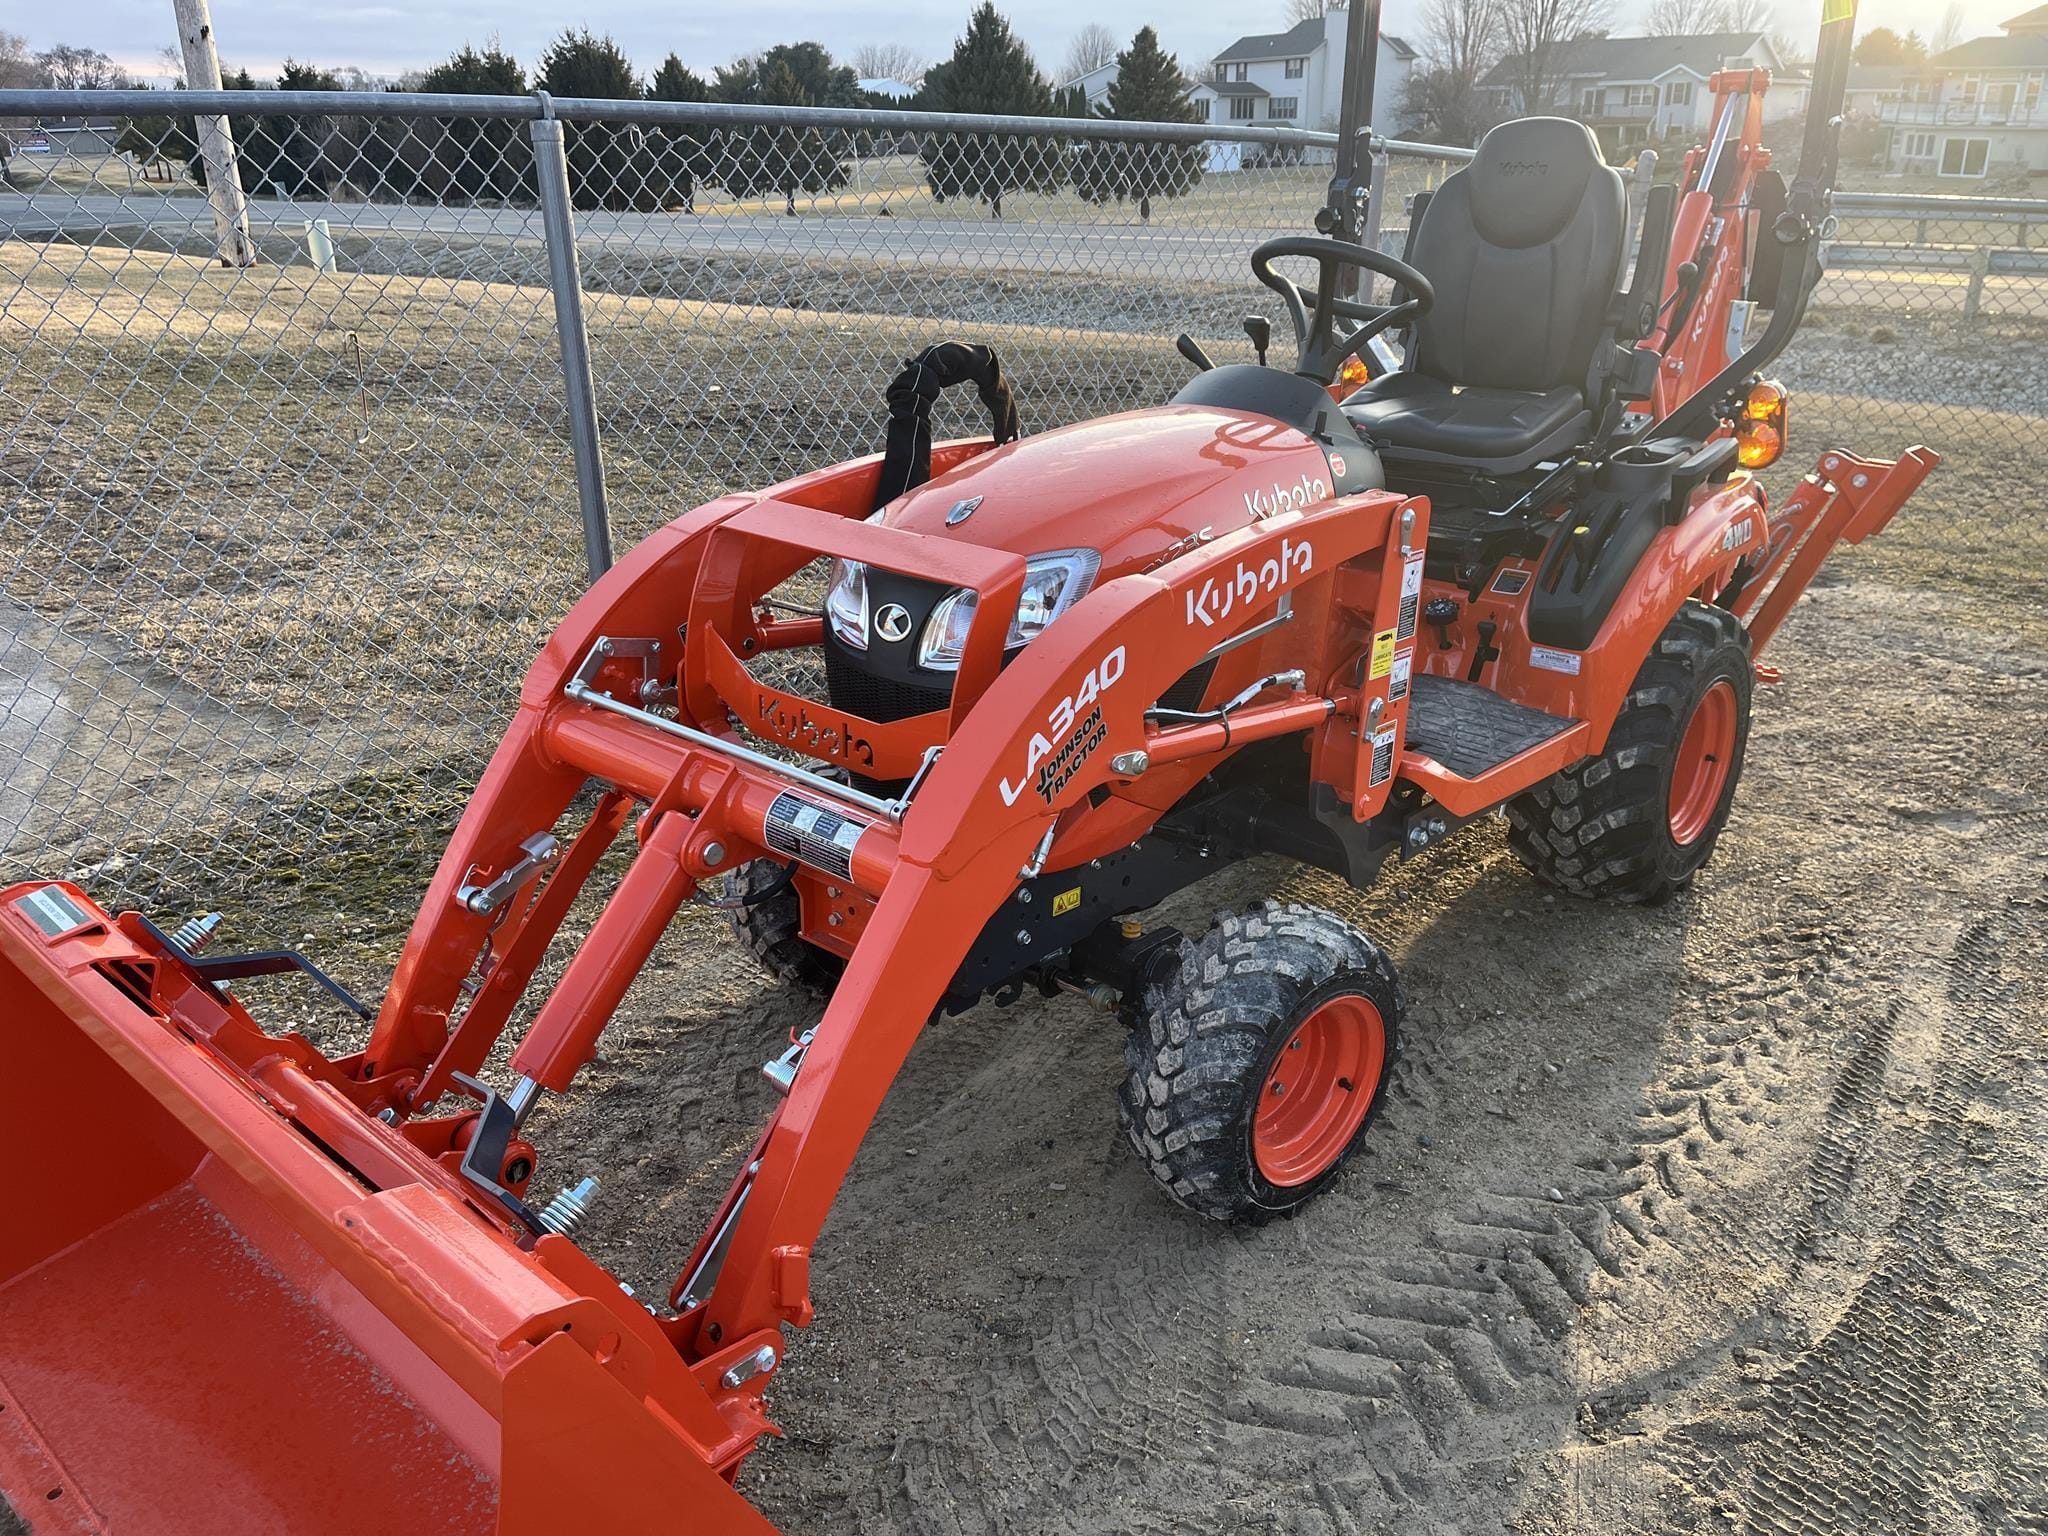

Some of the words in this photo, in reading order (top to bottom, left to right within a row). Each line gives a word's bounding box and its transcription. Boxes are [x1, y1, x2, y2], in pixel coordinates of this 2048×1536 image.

[1692, 246, 1728, 342] Kubota
[1244, 474, 1326, 520] Kubota
[1722, 517, 1753, 550] 4WD
[1141, 526, 1214, 573] 23S
[1186, 538, 1312, 627] Kubota
[759, 694, 874, 769] Kubota
[999, 645, 1126, 807] LA340
[1036, 706, 1102, 793] JOHNSON
[1041, 723, 1108, 806] TRACTOR
